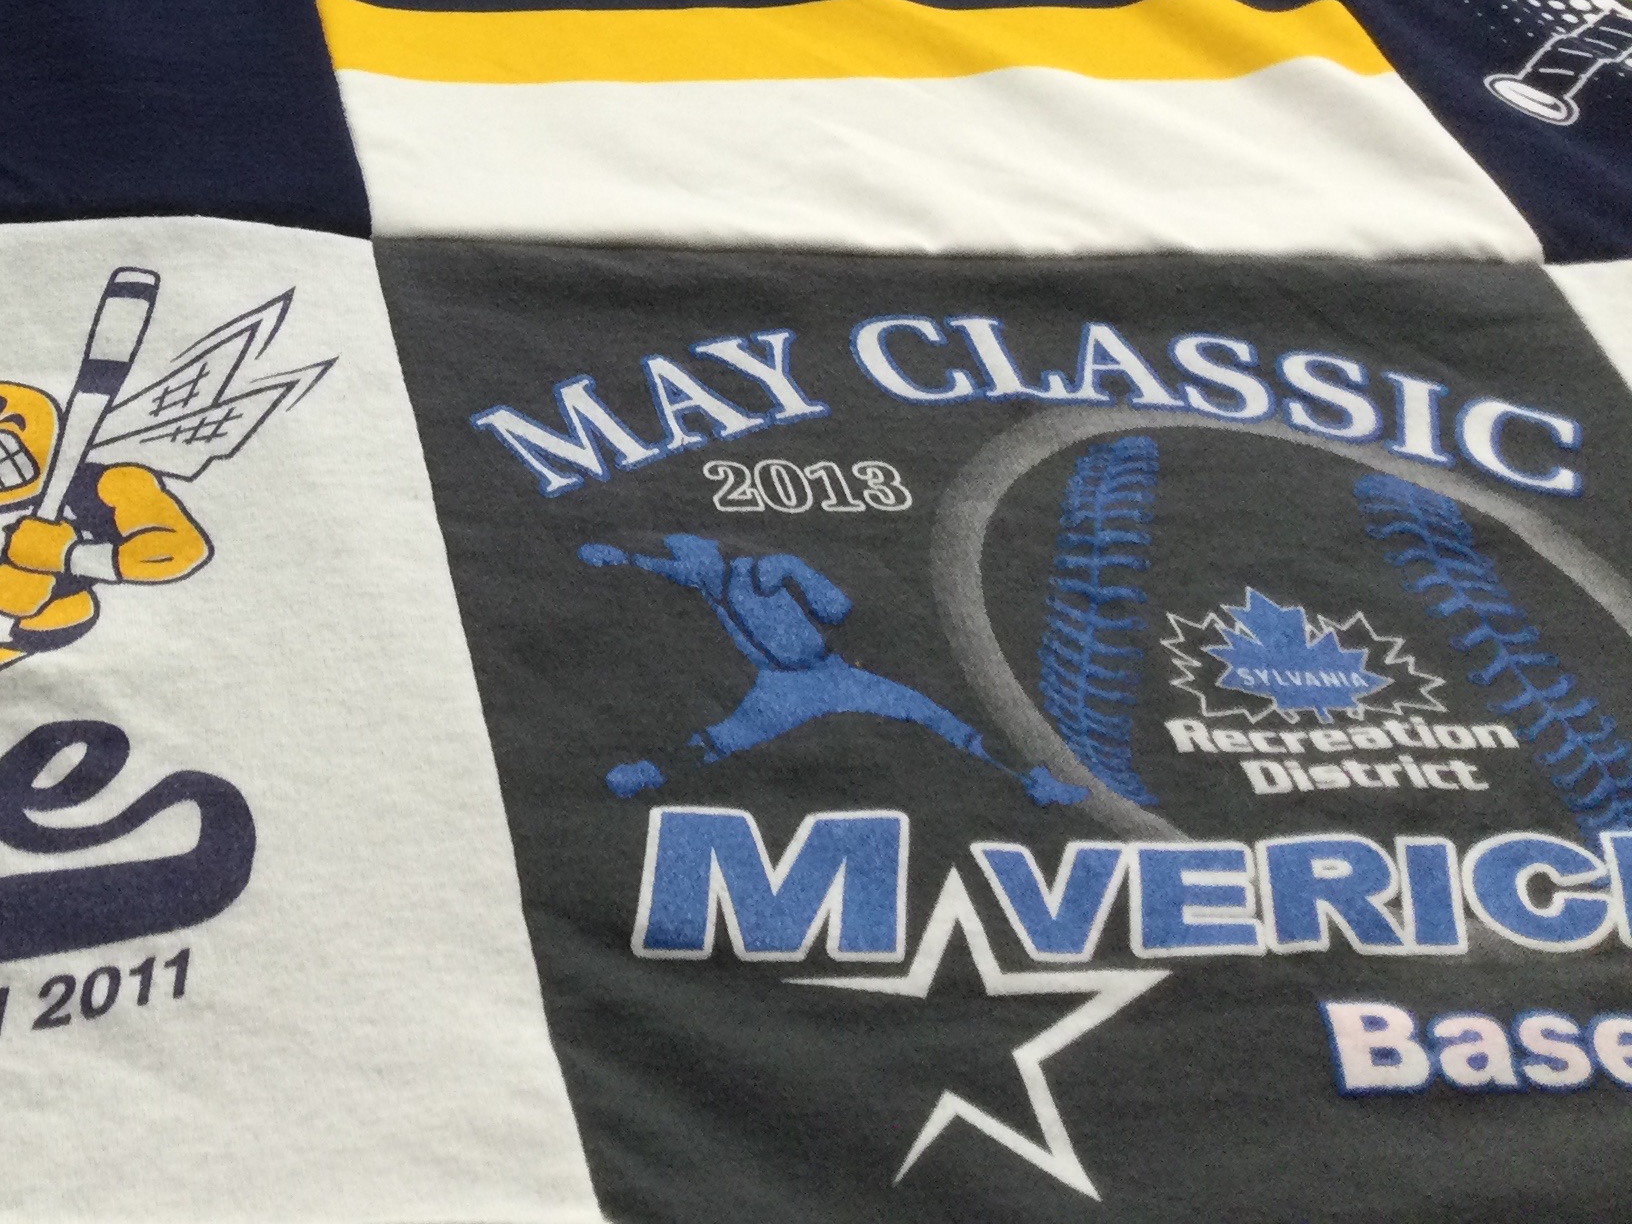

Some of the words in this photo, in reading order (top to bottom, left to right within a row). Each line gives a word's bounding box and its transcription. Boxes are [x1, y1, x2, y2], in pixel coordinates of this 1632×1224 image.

[471, 328, 832, 498] MAY
[849, 313, 1584, 495] CLASSIC
[702, 458, 914, 514] 2013
[1234, 664, 1372, 693] SYLVANIA
[1164, 717, 1522, 761] Recreation
[1239, 758, 1491, 796] District
[33, 948, 197, 1032] 2011
